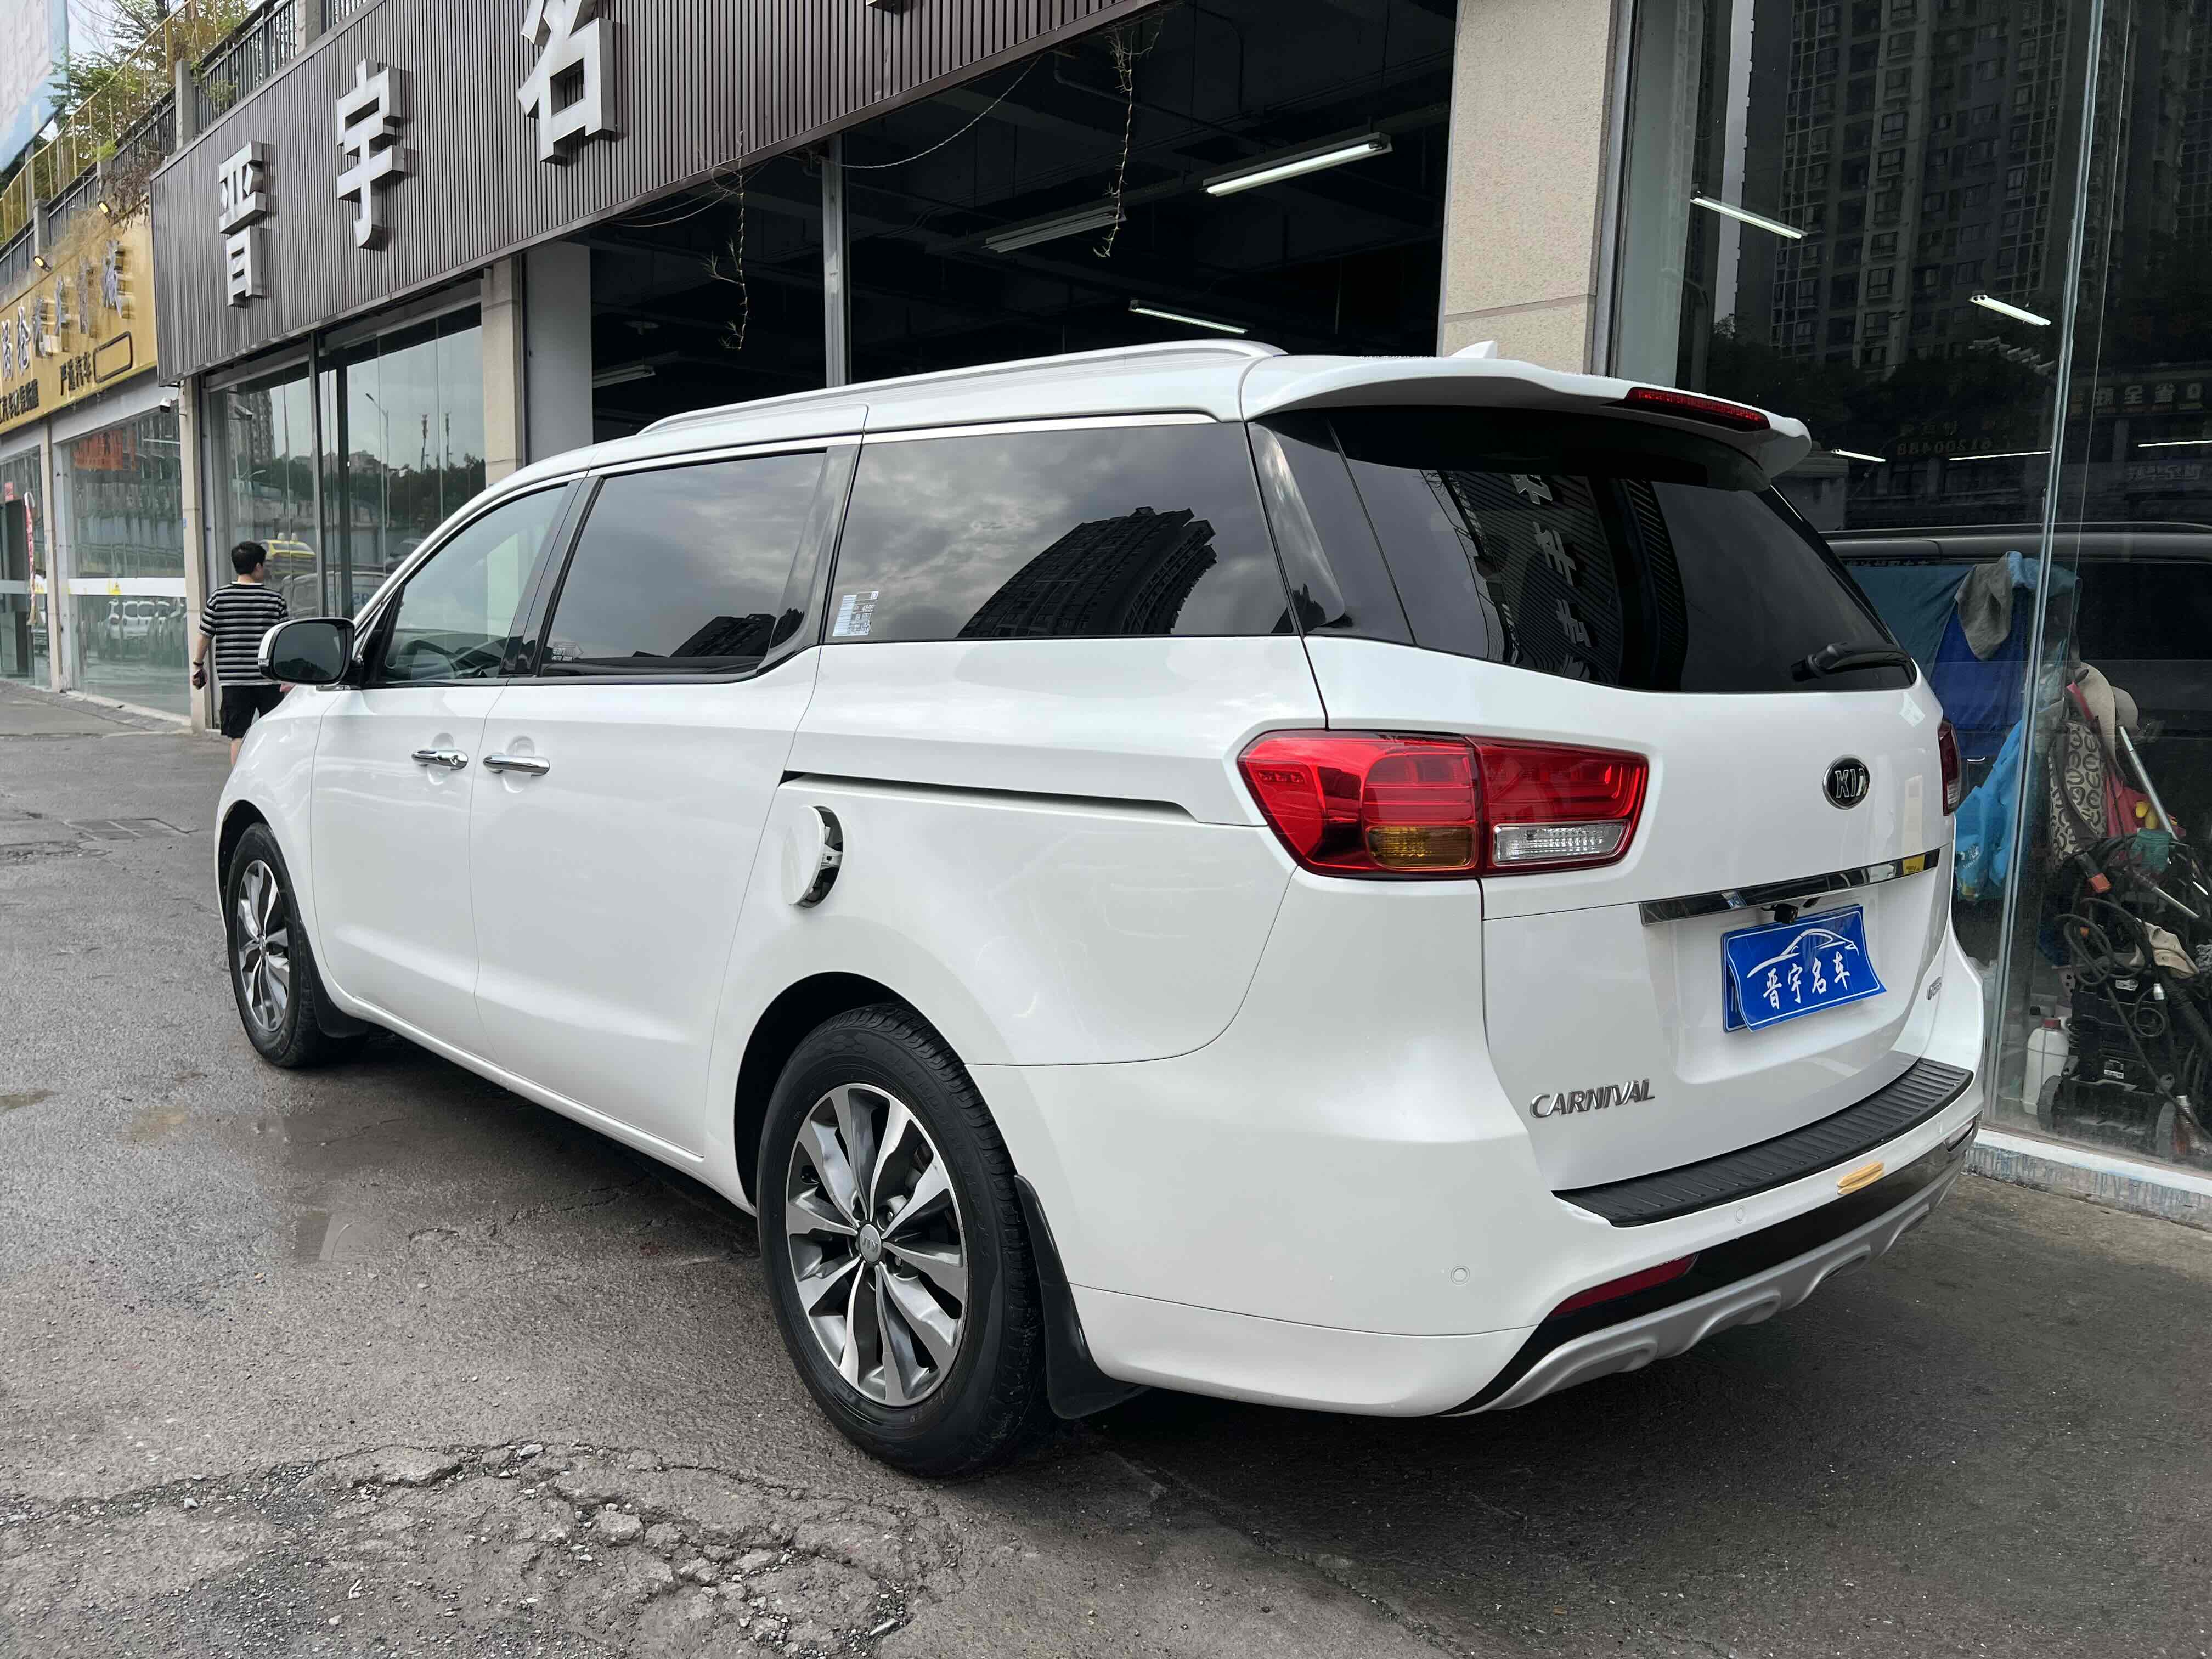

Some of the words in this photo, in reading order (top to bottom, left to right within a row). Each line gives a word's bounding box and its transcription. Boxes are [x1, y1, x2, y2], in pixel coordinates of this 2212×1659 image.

[218, 0, 910, 307] 晋宇名
[1835, 768, 1867, 798] KIA
[1763, 951, 1850, 1009] 晋宇名车
[1529, 1079, 1655, 1118] CARNIVAL
